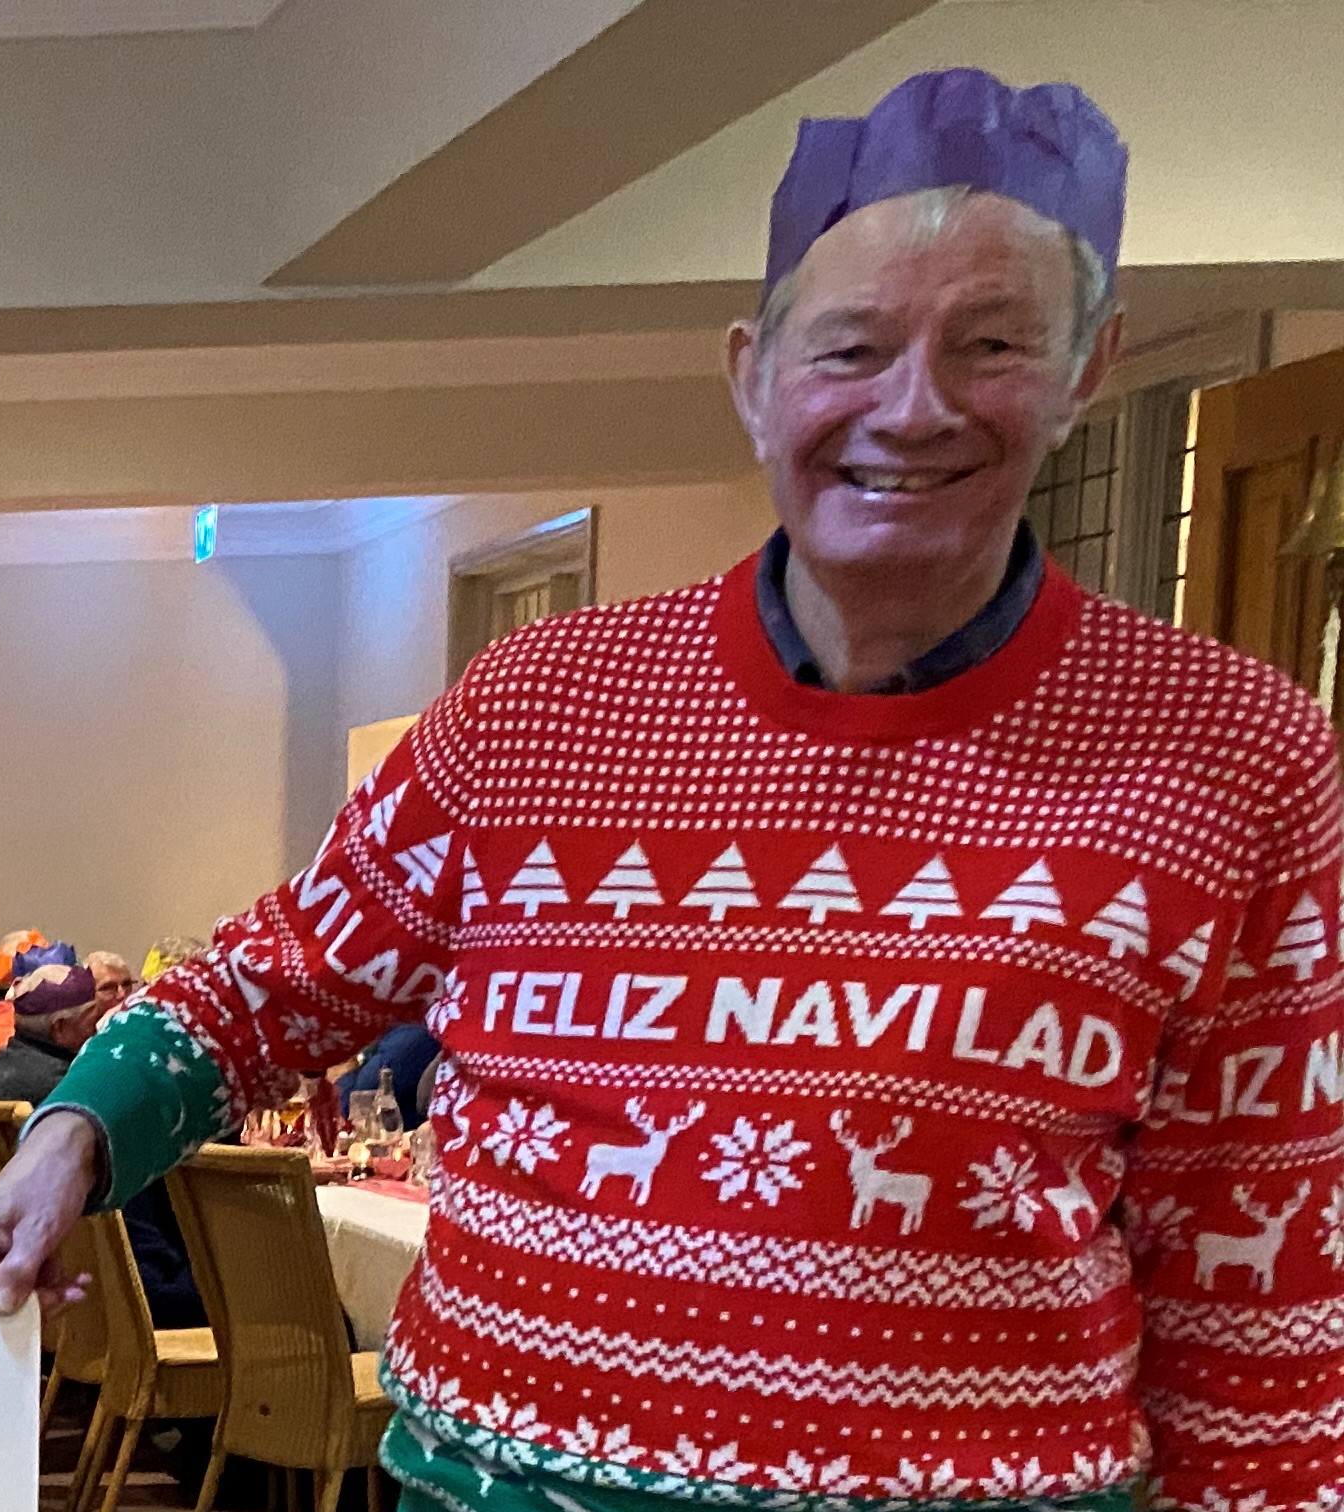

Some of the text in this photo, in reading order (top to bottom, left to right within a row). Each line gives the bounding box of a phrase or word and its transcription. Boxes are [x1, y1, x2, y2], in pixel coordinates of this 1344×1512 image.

[483, 971, 1124, 1087] FELIZ NAVI LAD
